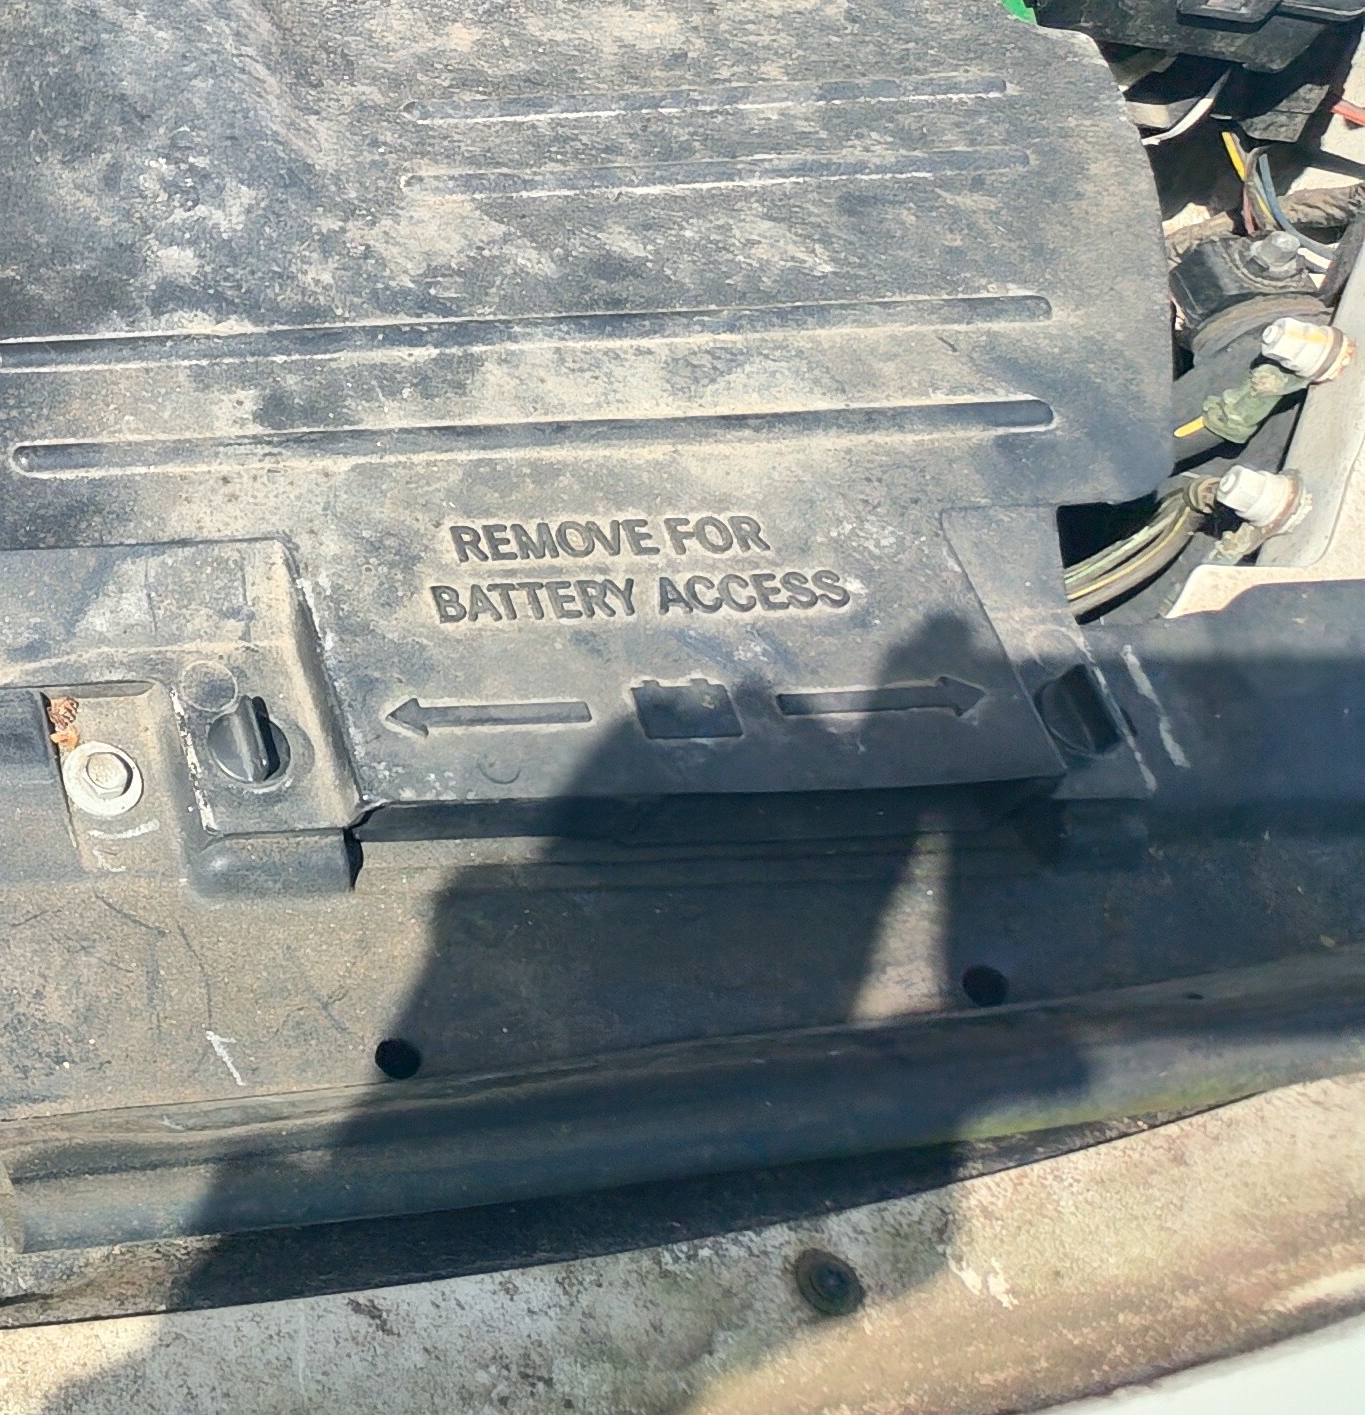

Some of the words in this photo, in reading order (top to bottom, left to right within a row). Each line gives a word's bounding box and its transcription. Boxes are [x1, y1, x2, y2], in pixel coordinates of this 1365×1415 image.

[448, 516, 662, 564] REMOVE
[664, 514, 773, 556] FOR
[430, 576, 636, 625] BATTERY
[657, 568, 853, 615] ACCESS
